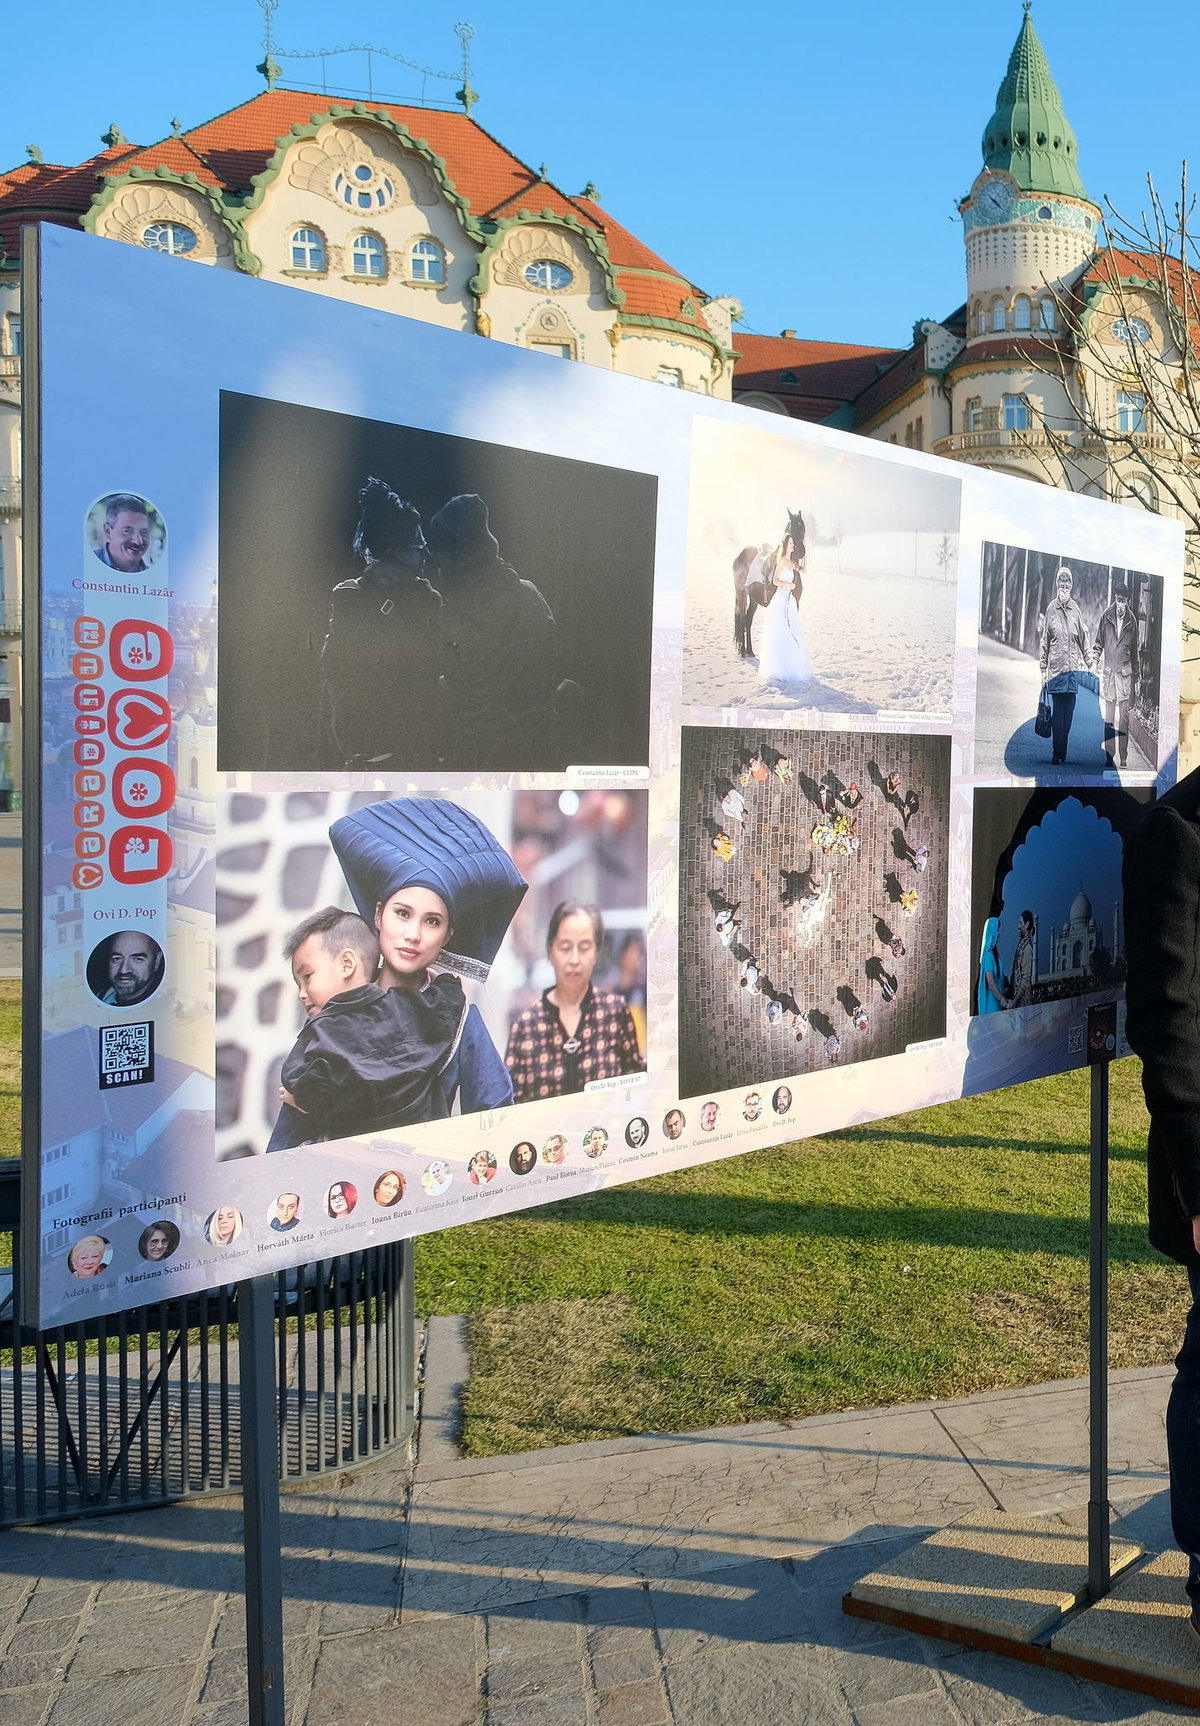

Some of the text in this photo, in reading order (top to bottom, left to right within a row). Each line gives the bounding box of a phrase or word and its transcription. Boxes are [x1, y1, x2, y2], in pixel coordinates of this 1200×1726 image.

[71, 578, 139, 595] Constantin
[93, 907, 157, 920] Ovi D. Pop
[106, 1070, 143, 1085] SCAN!
[52, 1192, 187, 1230] Fotografii participanți
[371, 1214, 392, 1225] Ioana
[256, 1232, 315, 1253] Horváth Márta
[124, 1262, 191, 1285] Mariana Scubli
[62, 1284, 90, 1300] Adela
